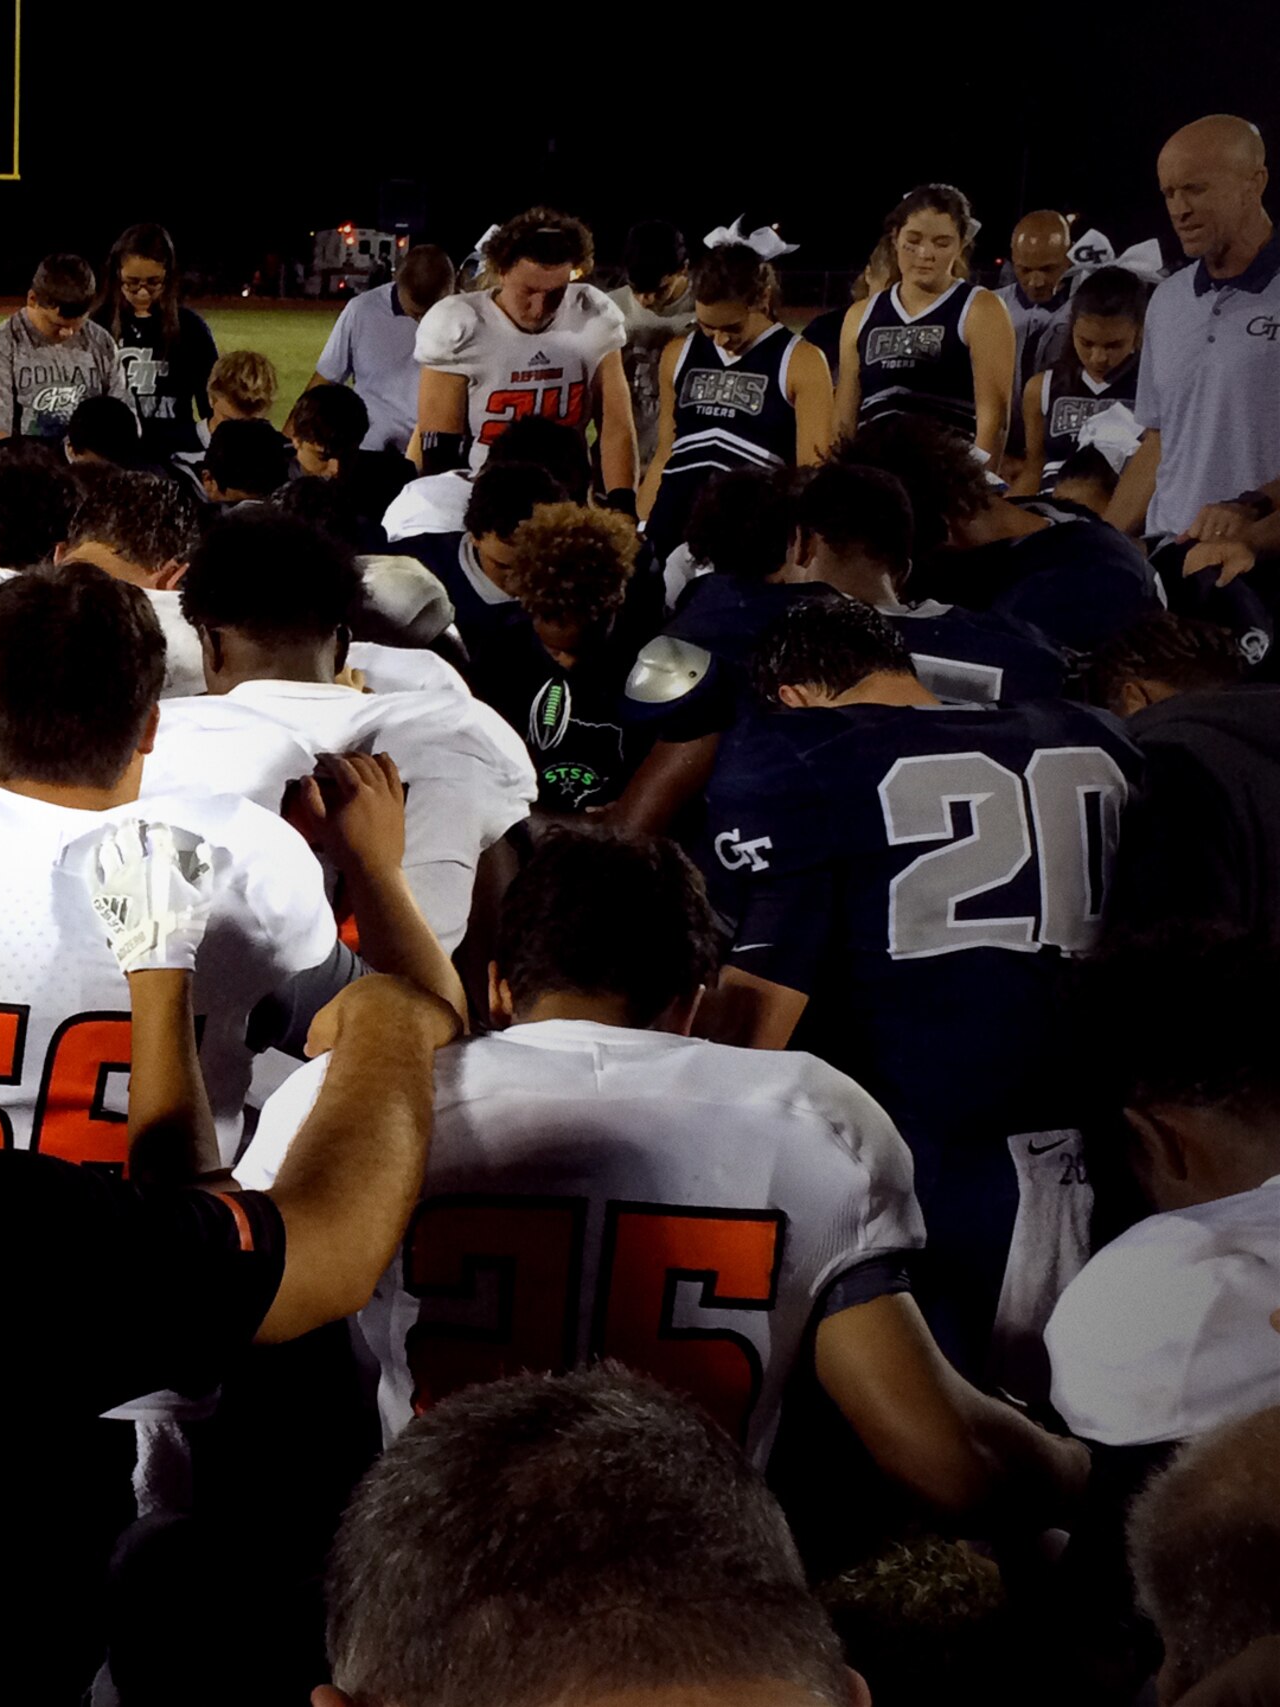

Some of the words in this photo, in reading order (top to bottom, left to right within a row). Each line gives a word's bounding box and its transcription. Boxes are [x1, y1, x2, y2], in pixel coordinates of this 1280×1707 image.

[1246, 316, 1280, 341] GT
[696, 404, 736, 418] TIGERS
[545, 767, 595, 785] STSS
[714, 828, 773, 872] GT
[878, 746, 1128, 960] 20
[404, 1195, 787, 1442] 25
